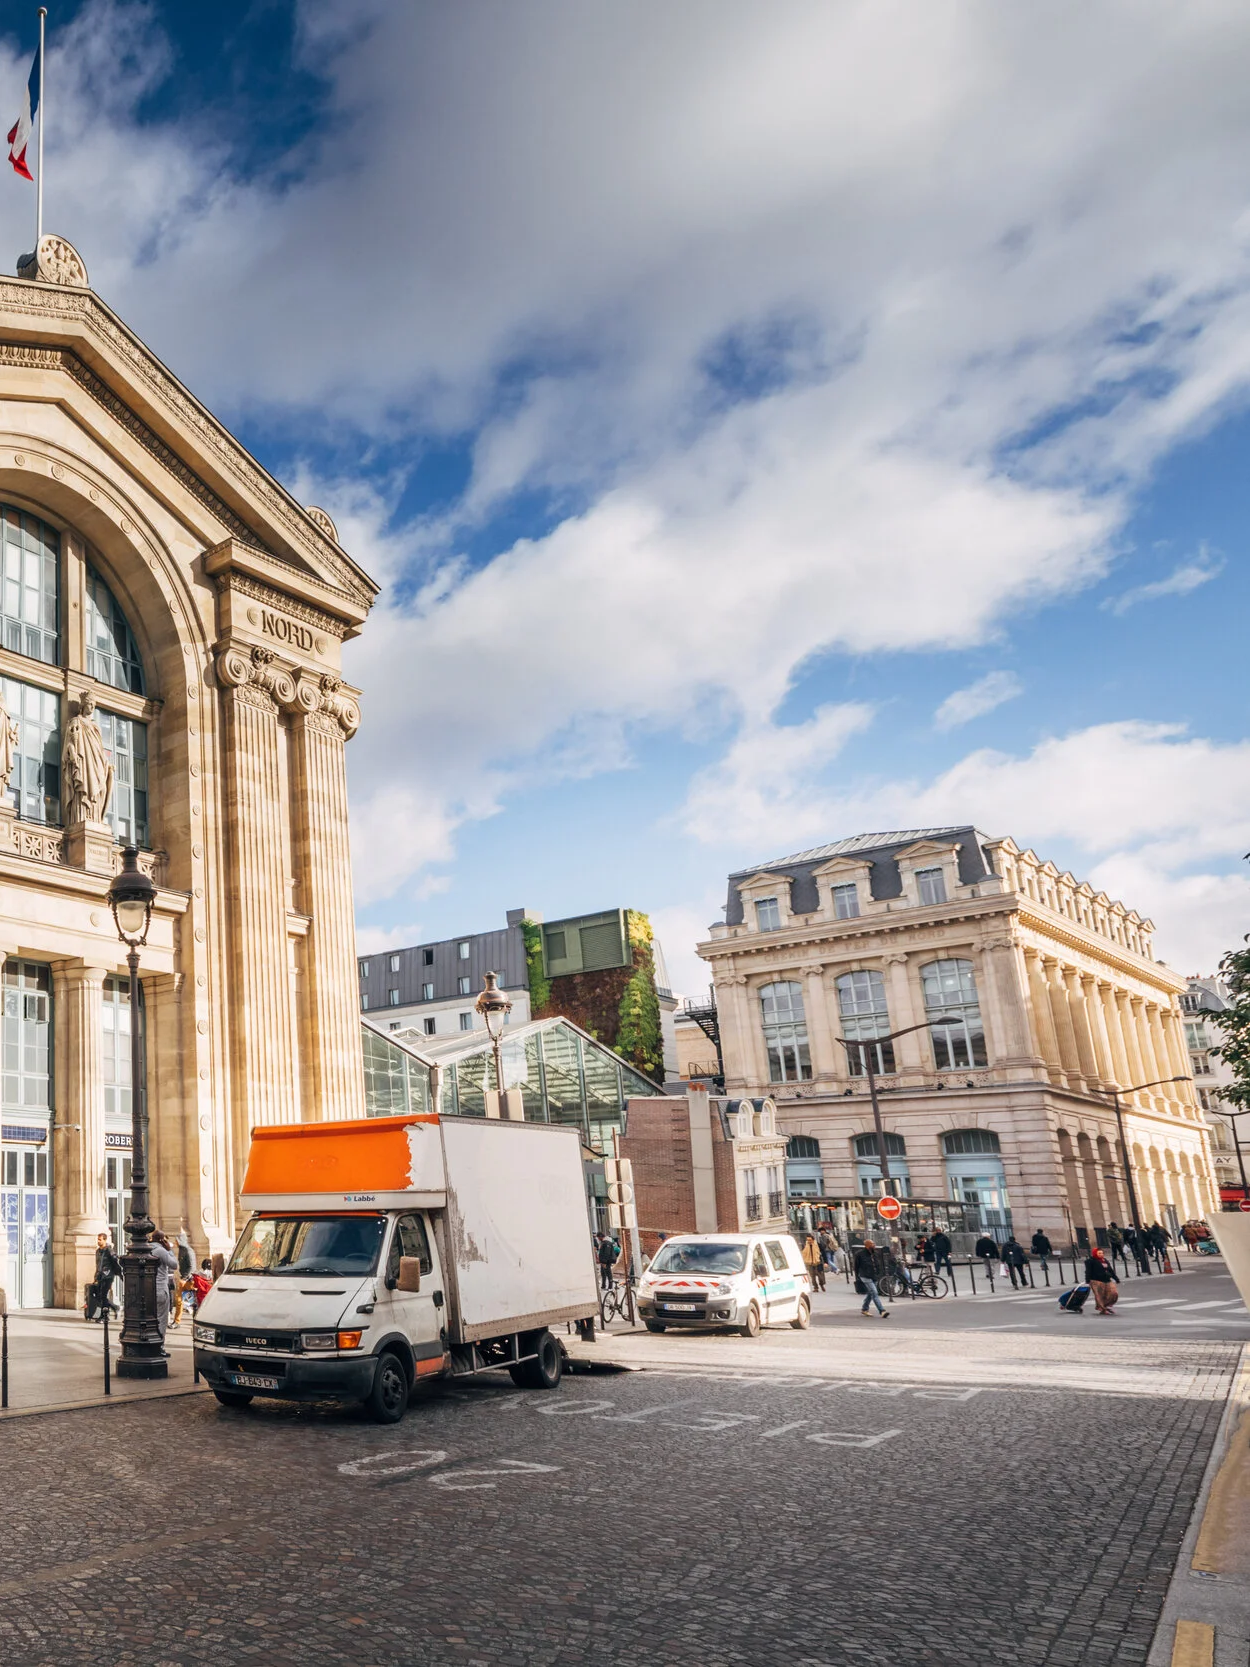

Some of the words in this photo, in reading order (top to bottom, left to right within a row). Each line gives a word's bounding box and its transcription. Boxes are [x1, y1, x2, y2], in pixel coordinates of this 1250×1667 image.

[261, 609, 314, 652] NORD
[764, 947, 809, 963] CHEMIN
[818, 945, 835, 955] DE
[845, 939, 870, 951] FER
[880, 935, 898, 946] DU
[909, 928, 946, 942] NORD
[246, 1337, 267, 1345] IVECO
